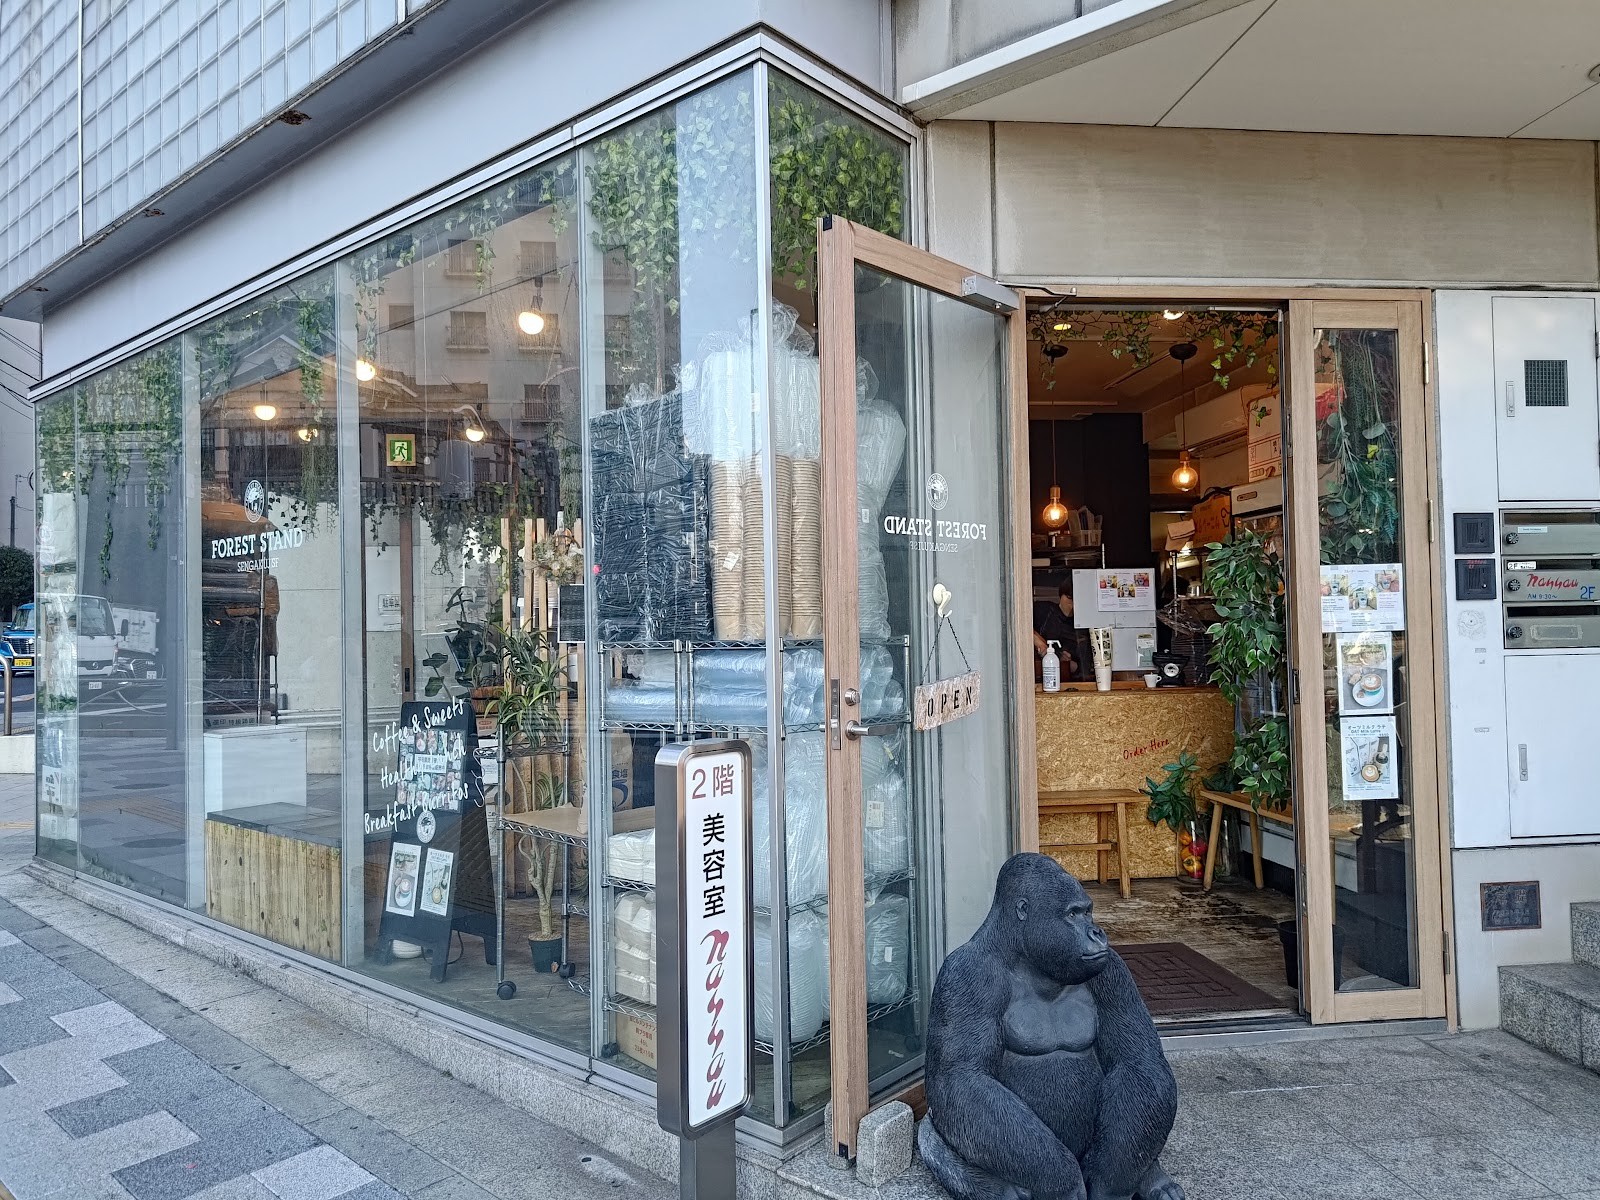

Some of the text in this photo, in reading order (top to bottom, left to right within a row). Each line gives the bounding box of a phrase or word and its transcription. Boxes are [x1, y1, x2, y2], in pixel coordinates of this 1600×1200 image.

[211, 527, 303, 559] FOREST STAND
[1580, 586, 1596, 600] 2F
[928, 686, 972, 717] OPEN
[372, 696, 465, 755] Coffee & Sweets
[1123, 738, 1170, 760] Order Here
[380, 756, 424, 789] Healthy
[692, 763, 734, 799] 2階
[364, 800, 418, 834] Breakfast
[421, 783, 468, 813] Burritos
[702, 812, 725, 919] 美容室
